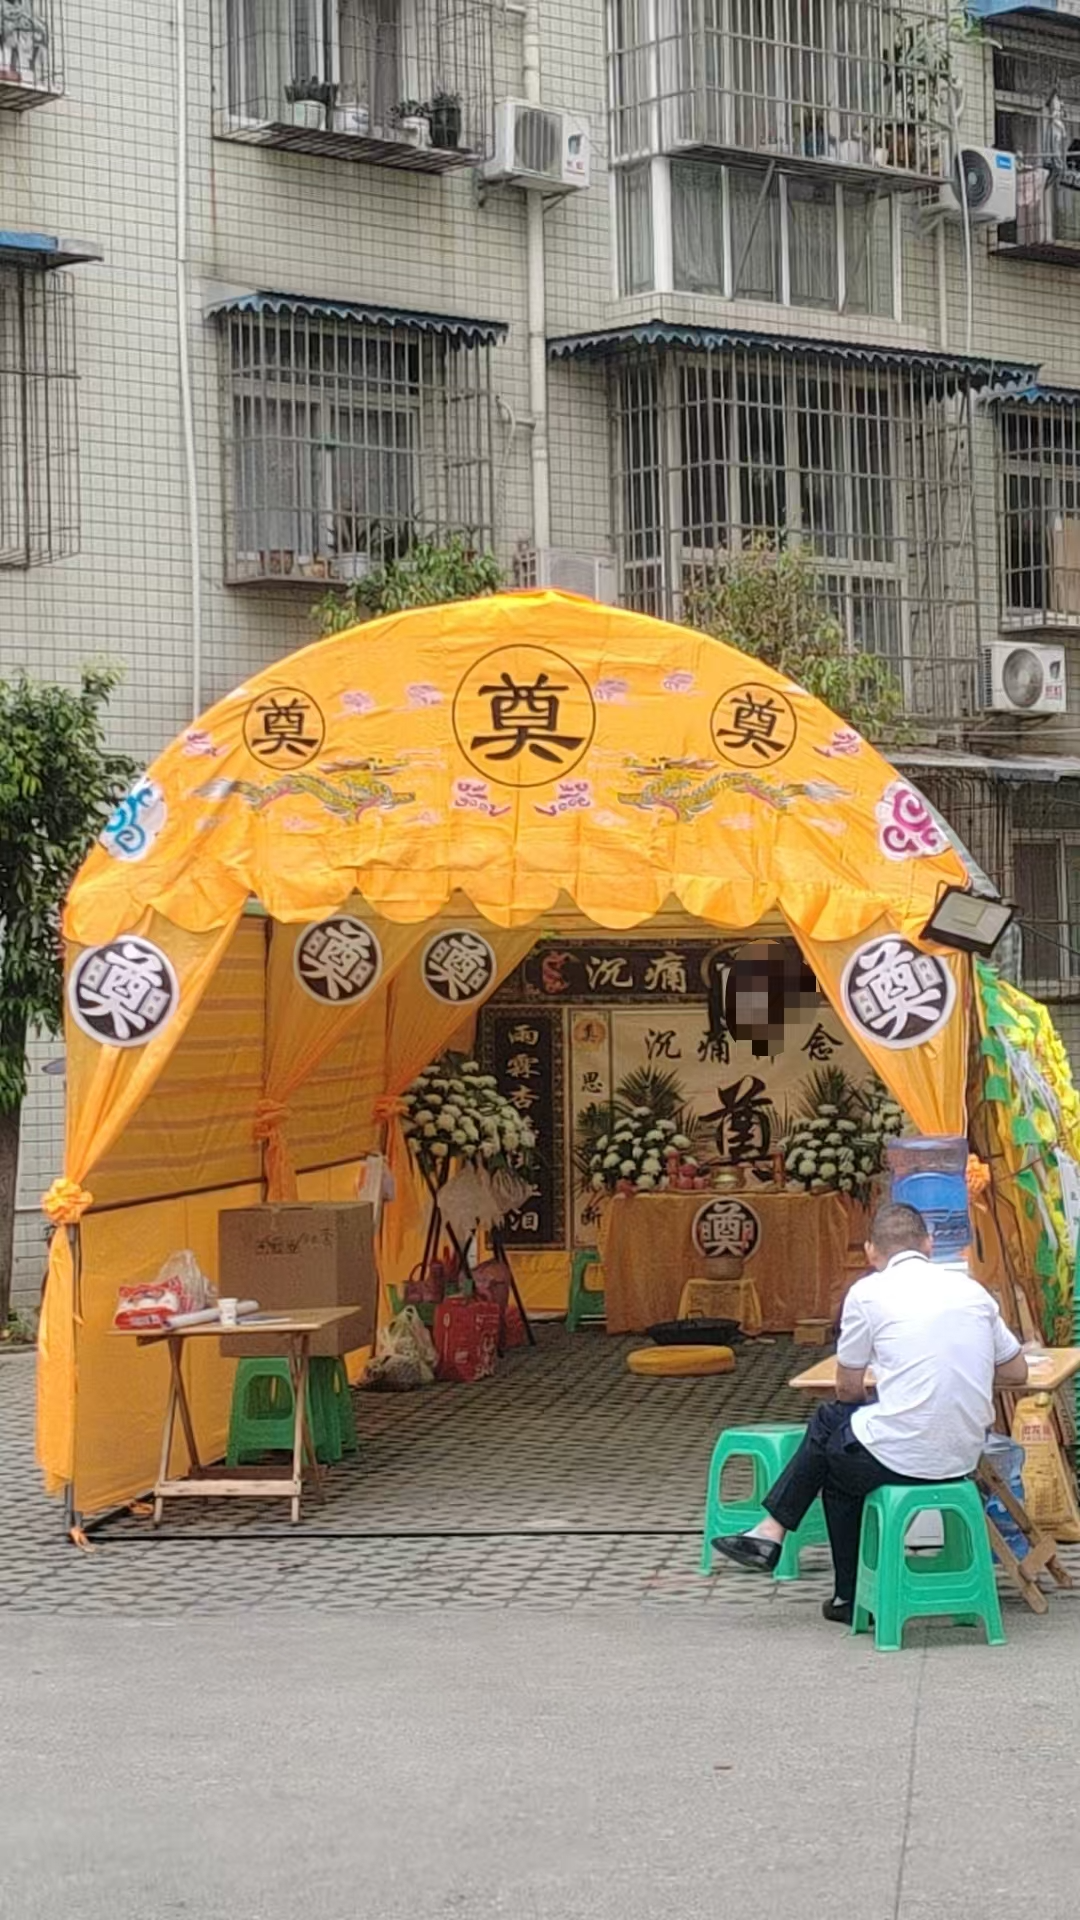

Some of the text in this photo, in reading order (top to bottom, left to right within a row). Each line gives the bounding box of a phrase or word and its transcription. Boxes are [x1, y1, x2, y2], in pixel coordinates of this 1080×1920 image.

[251, 697, 319, 757] 奠
[470, 672, 586, 764] 奠
[716, 691, 787, 760] 奠
[79, 942, 165, 1040] 奠
[300, 920, 372, 1000] 奠
[426, 934, 487, 1000] 奠
[586, 950, 688, 993] 沉痛
[856, 940, 942, 1039] 奠
[643, 1023, 844, 1065] 沉痛念
[702, 1202, 750, 1258] 奠
